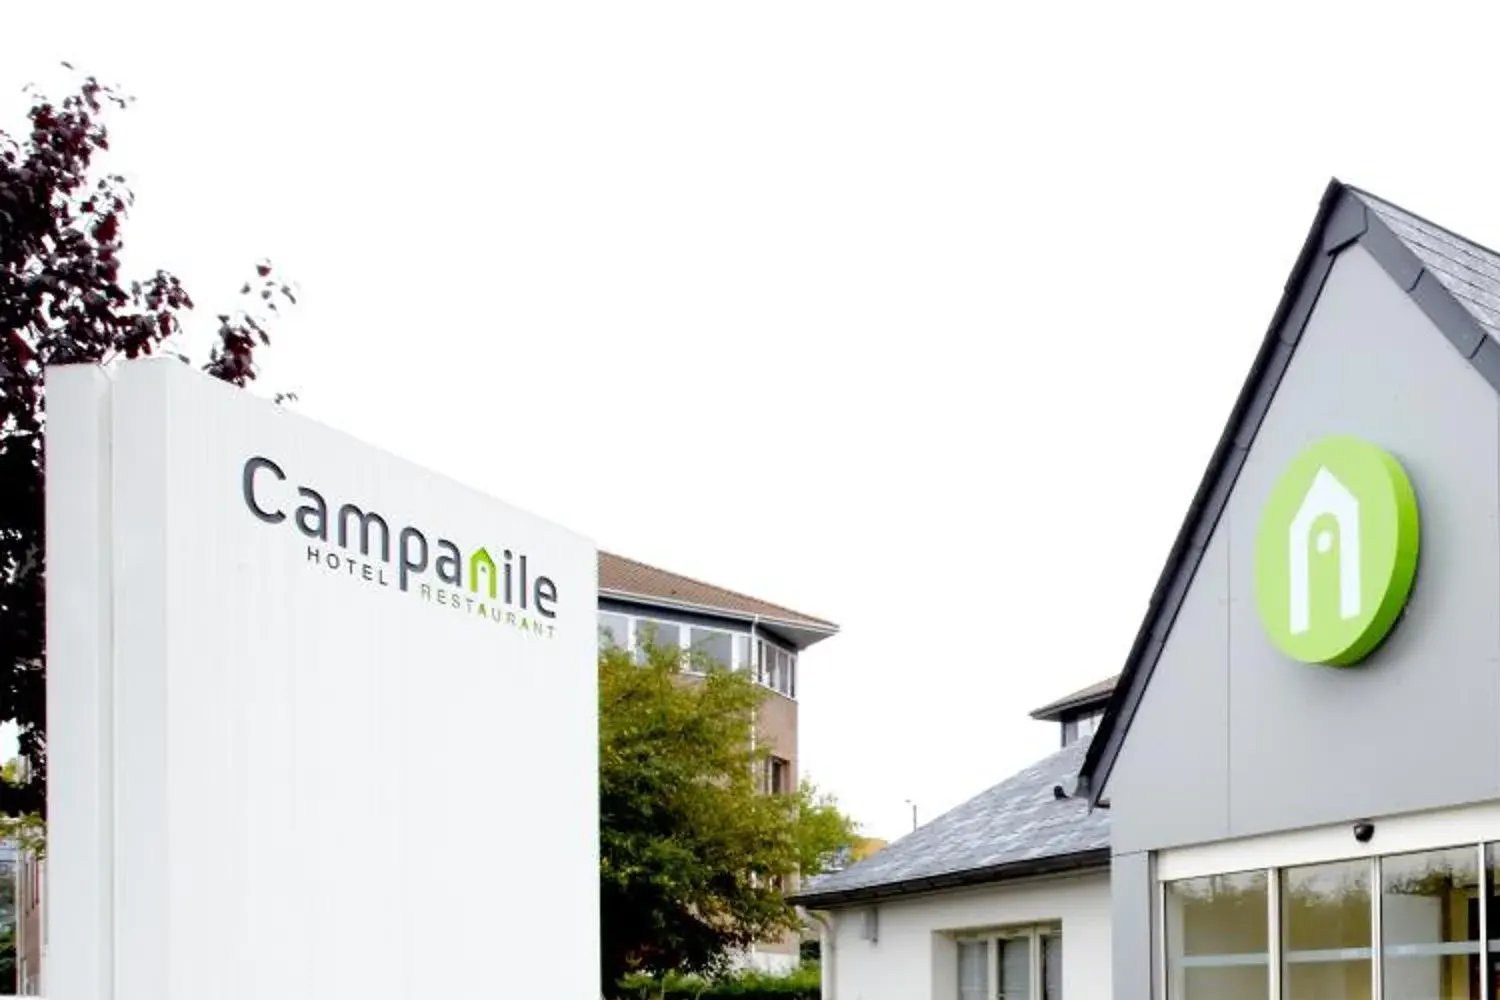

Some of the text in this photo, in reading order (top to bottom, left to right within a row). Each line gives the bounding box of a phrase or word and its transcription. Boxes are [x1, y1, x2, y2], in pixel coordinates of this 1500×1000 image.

[243, 455, 558, 619] Campanile
[307, 545, 557, 640] HOTEL RESTAURANT
